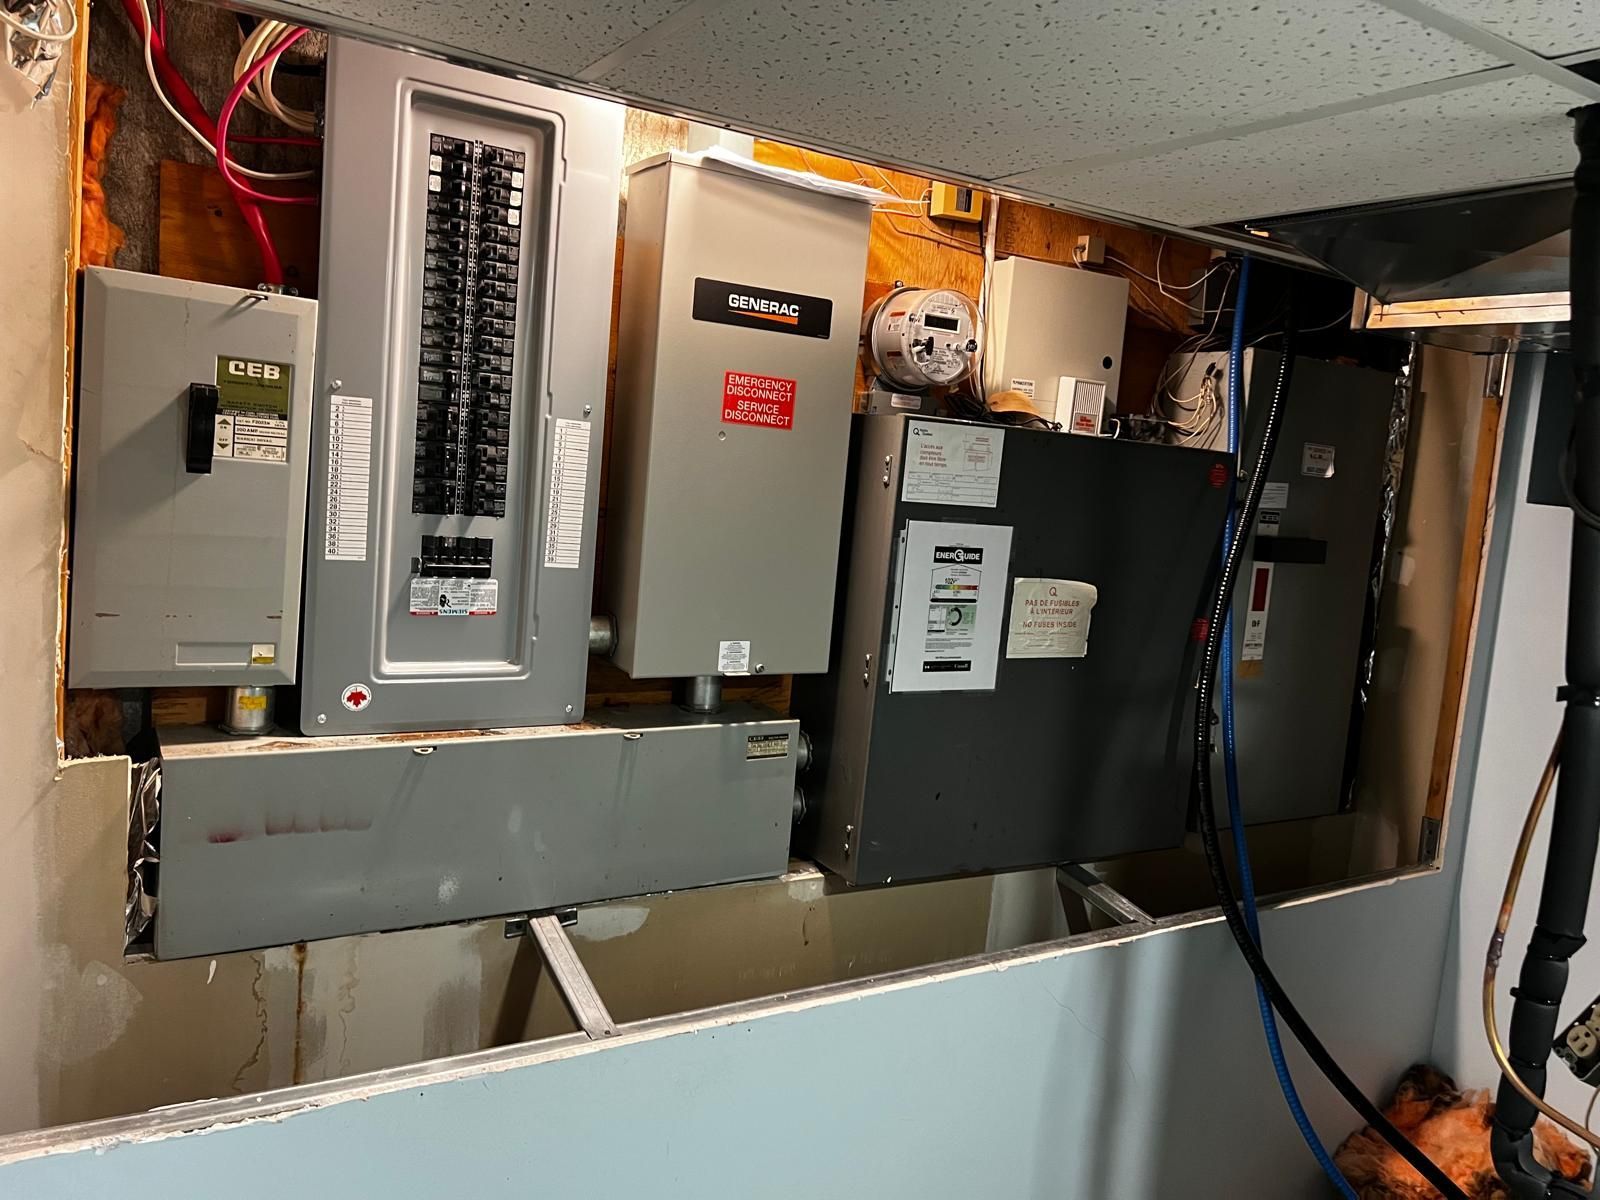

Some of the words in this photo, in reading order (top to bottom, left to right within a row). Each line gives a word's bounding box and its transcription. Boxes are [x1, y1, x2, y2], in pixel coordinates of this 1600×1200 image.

[728, 294, 799, 316] GENERAC
[228, 360, 280, 380] CEB
[728, 374, 792, 391] EMERGENCY
[727, 385, 792, 402] DISCONNECT
[737, 400, 779, 414] SERVICE
[724, 410, 790, 425] DISCONNECT
[935, 549, 980, 562] ENERGUIDE
[1049, 587, 1057, 596] Q
